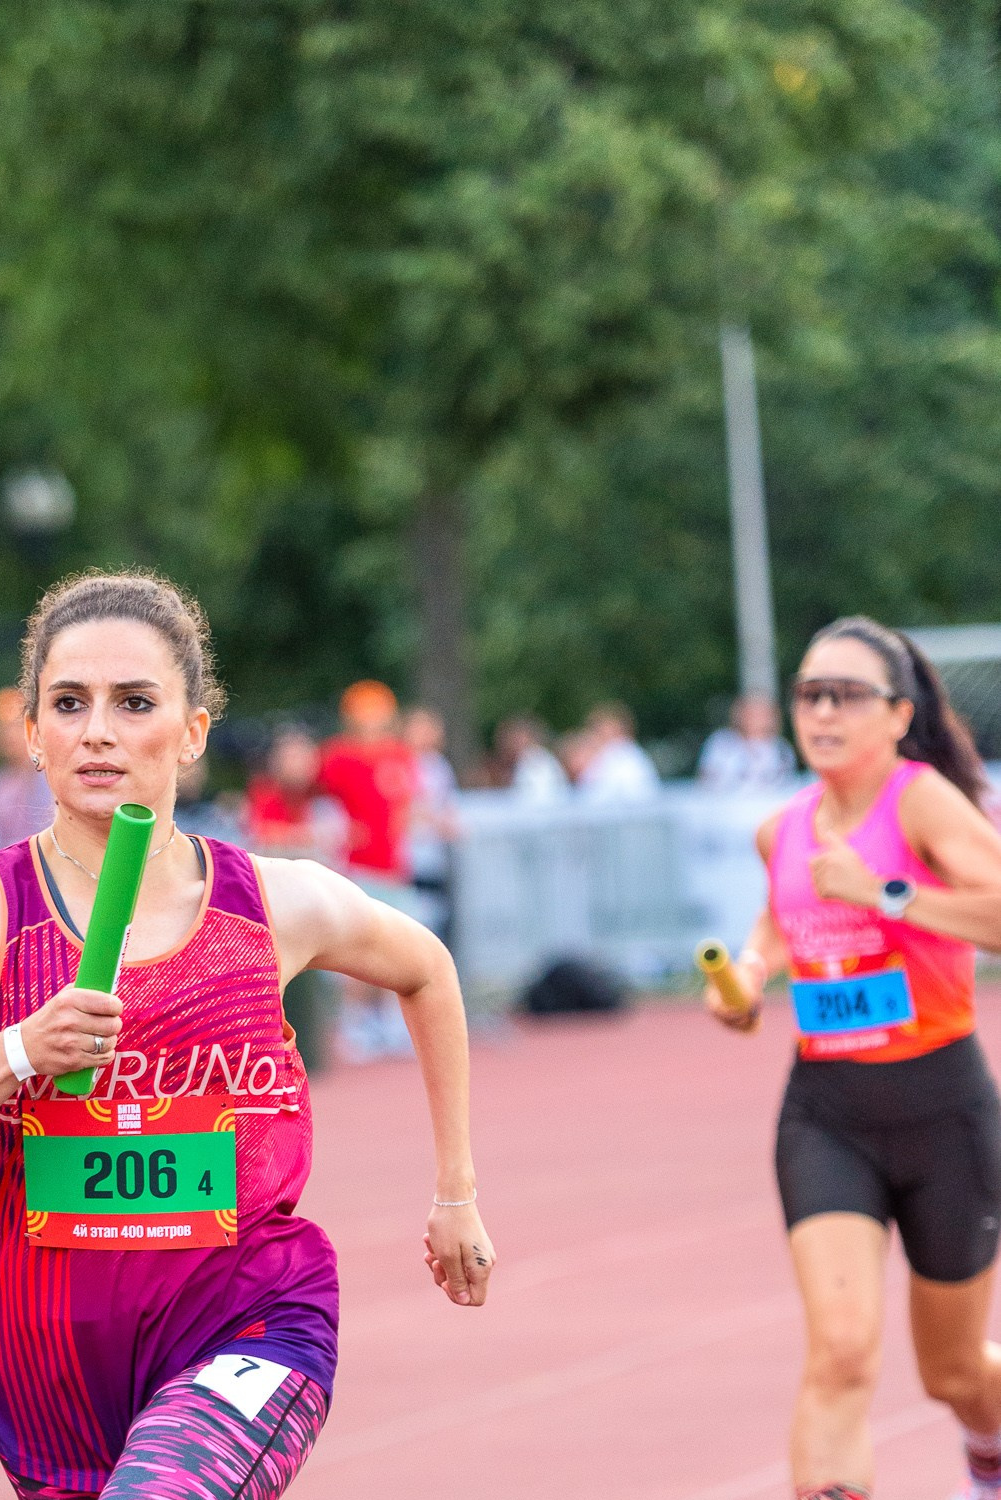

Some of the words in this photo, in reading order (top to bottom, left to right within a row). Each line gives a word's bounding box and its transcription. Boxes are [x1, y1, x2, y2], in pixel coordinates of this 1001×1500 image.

[117, 1103, 141, 1114] БИТВА
[84, 1149, 178, 1200] 206
[197, 1169, 214, 1197] 4
[72, 1223, 88, 1238] 4й
[90, 1226, 118, 1238] этап
[120, 1225, 144, 1239] 400
[146, 1225, 192, 1239] метров
[234, 1357, 261, 1378] 7
